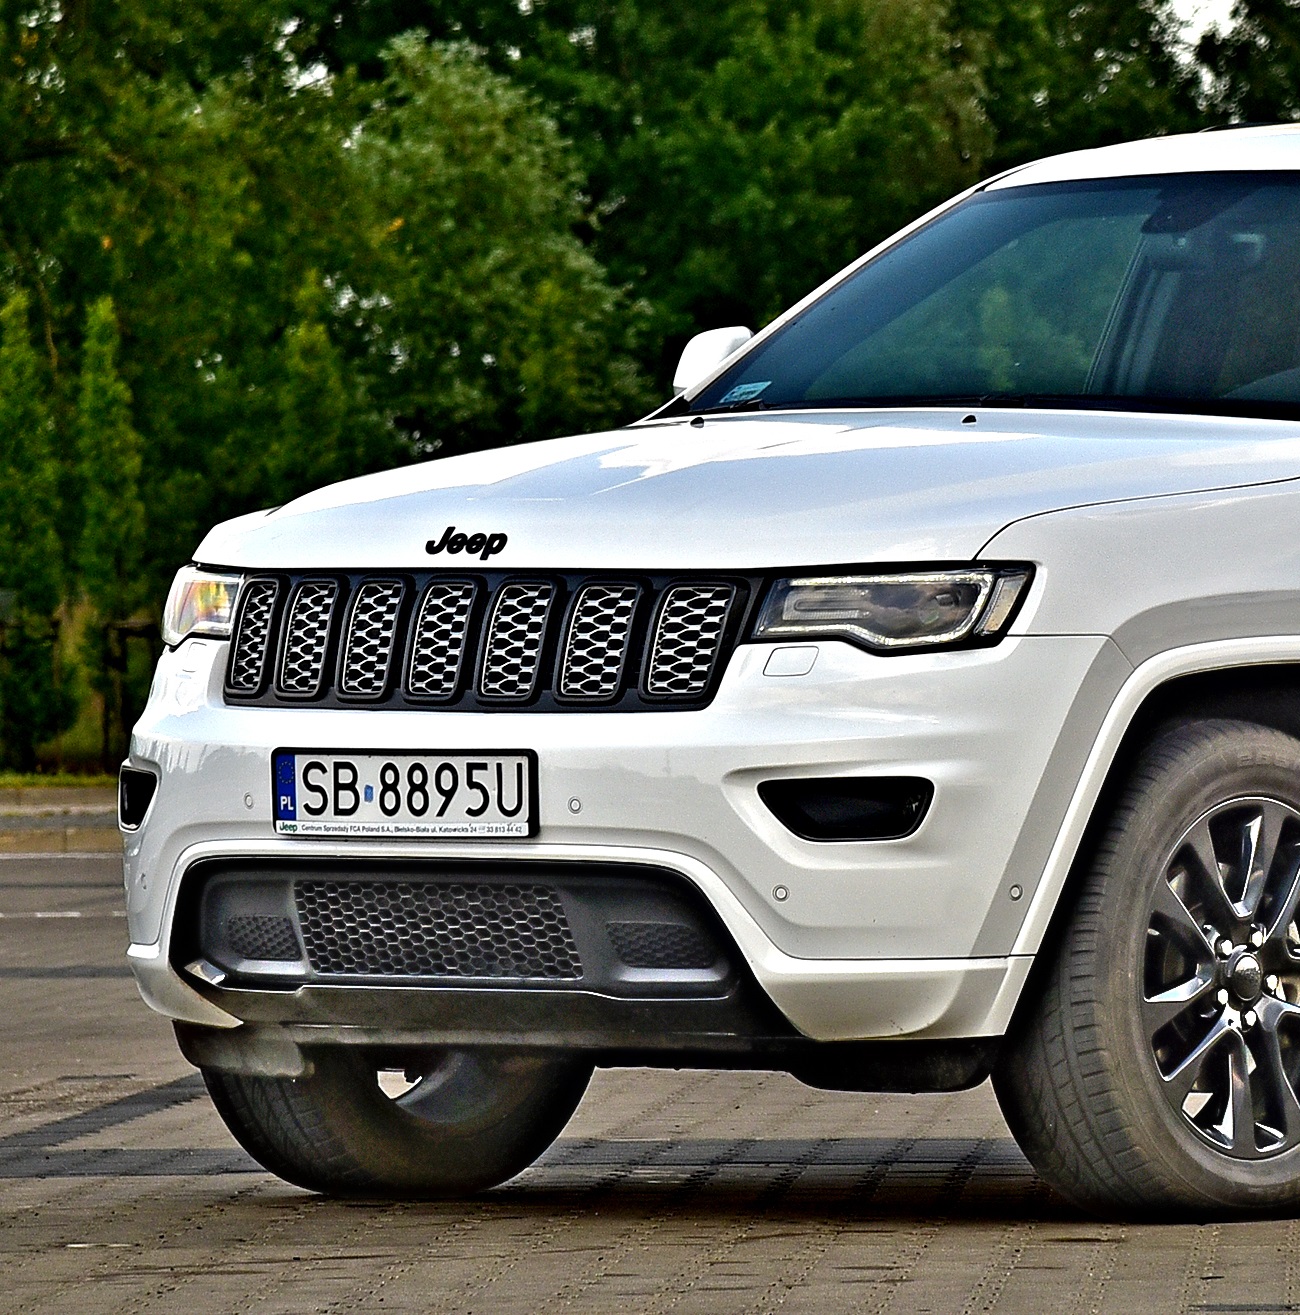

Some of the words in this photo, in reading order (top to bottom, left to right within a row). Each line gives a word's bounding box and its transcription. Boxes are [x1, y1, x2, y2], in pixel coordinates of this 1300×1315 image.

[425, 526, 508, 561] Jeep
[302, 761, 360, 817] SB
[379, 762, 523, 818] 8895U
[280, 796, 294, 811] PL
[279, 822, 298, 833] Jeep
[301, 824, 322, 832] Centrum
[349, 825, 361, 833] FCA
[362, 825, 380, 833] Poland
